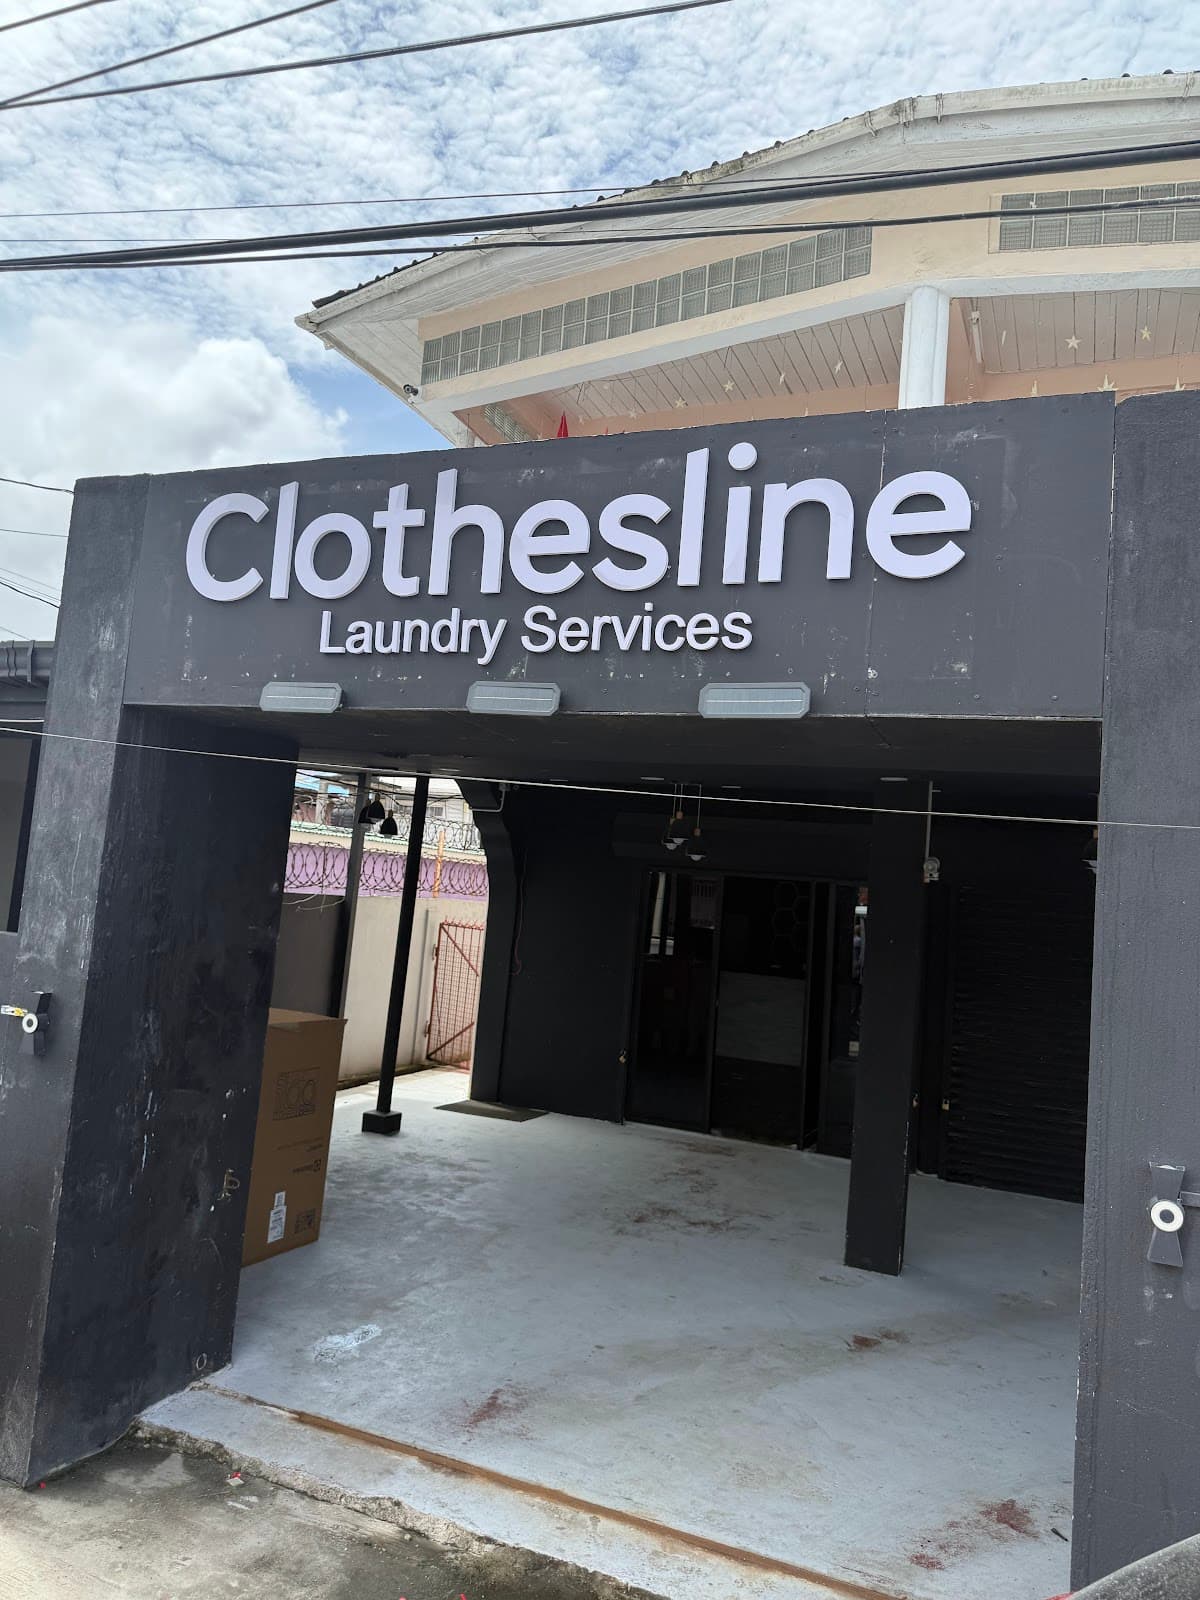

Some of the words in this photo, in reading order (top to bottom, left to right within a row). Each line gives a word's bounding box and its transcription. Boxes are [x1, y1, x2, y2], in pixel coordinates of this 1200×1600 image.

[186, 442, 973, 601] Clothesline
[319, 608, 505, 665] Laundry
[520, 602, 753, 653] Services
